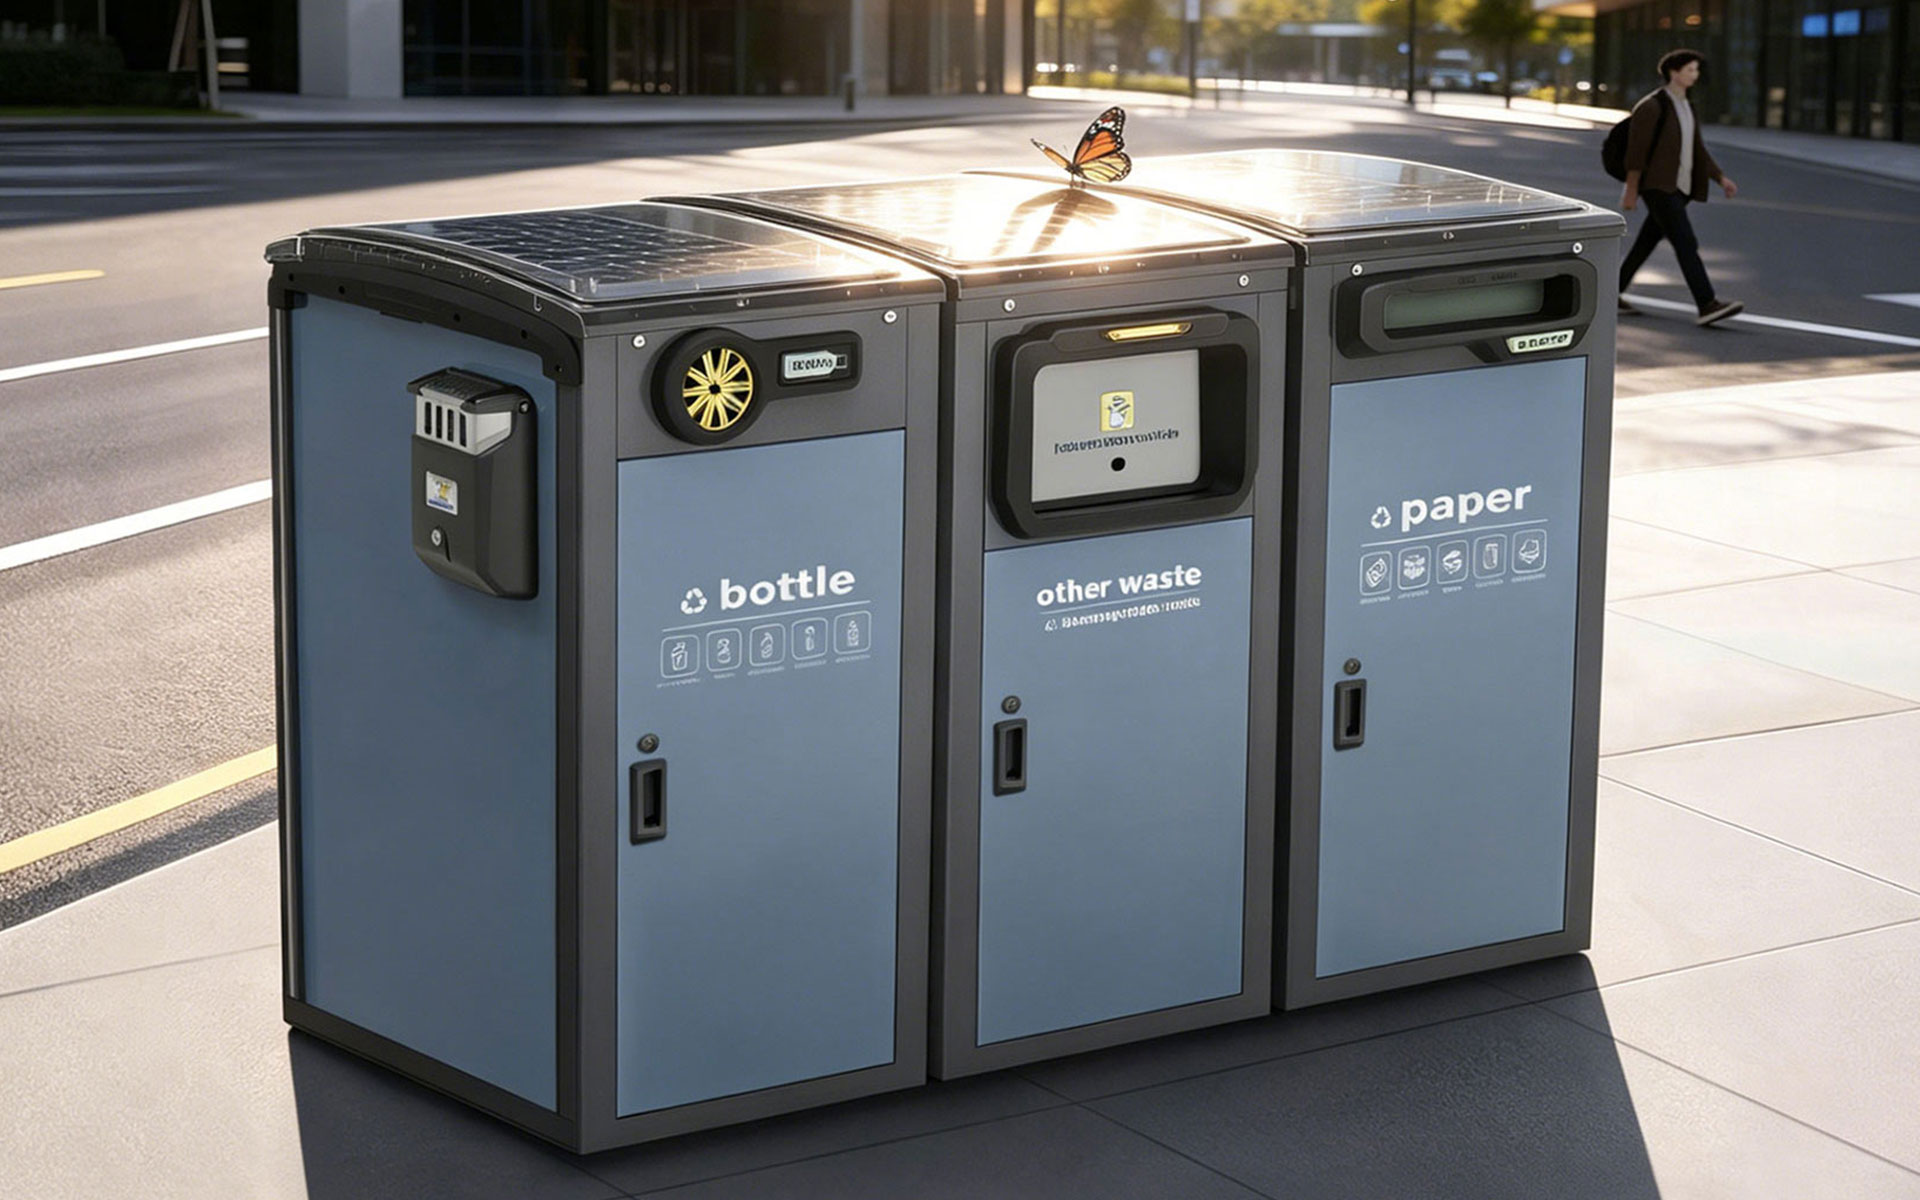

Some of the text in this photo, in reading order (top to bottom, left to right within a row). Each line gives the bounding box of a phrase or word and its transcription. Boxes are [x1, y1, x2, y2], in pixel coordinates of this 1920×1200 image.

[1401, 485, 1532, 532] paper
[720, 565, 856, 610] bottle
[1036, 564, 1202, 606] other waste
